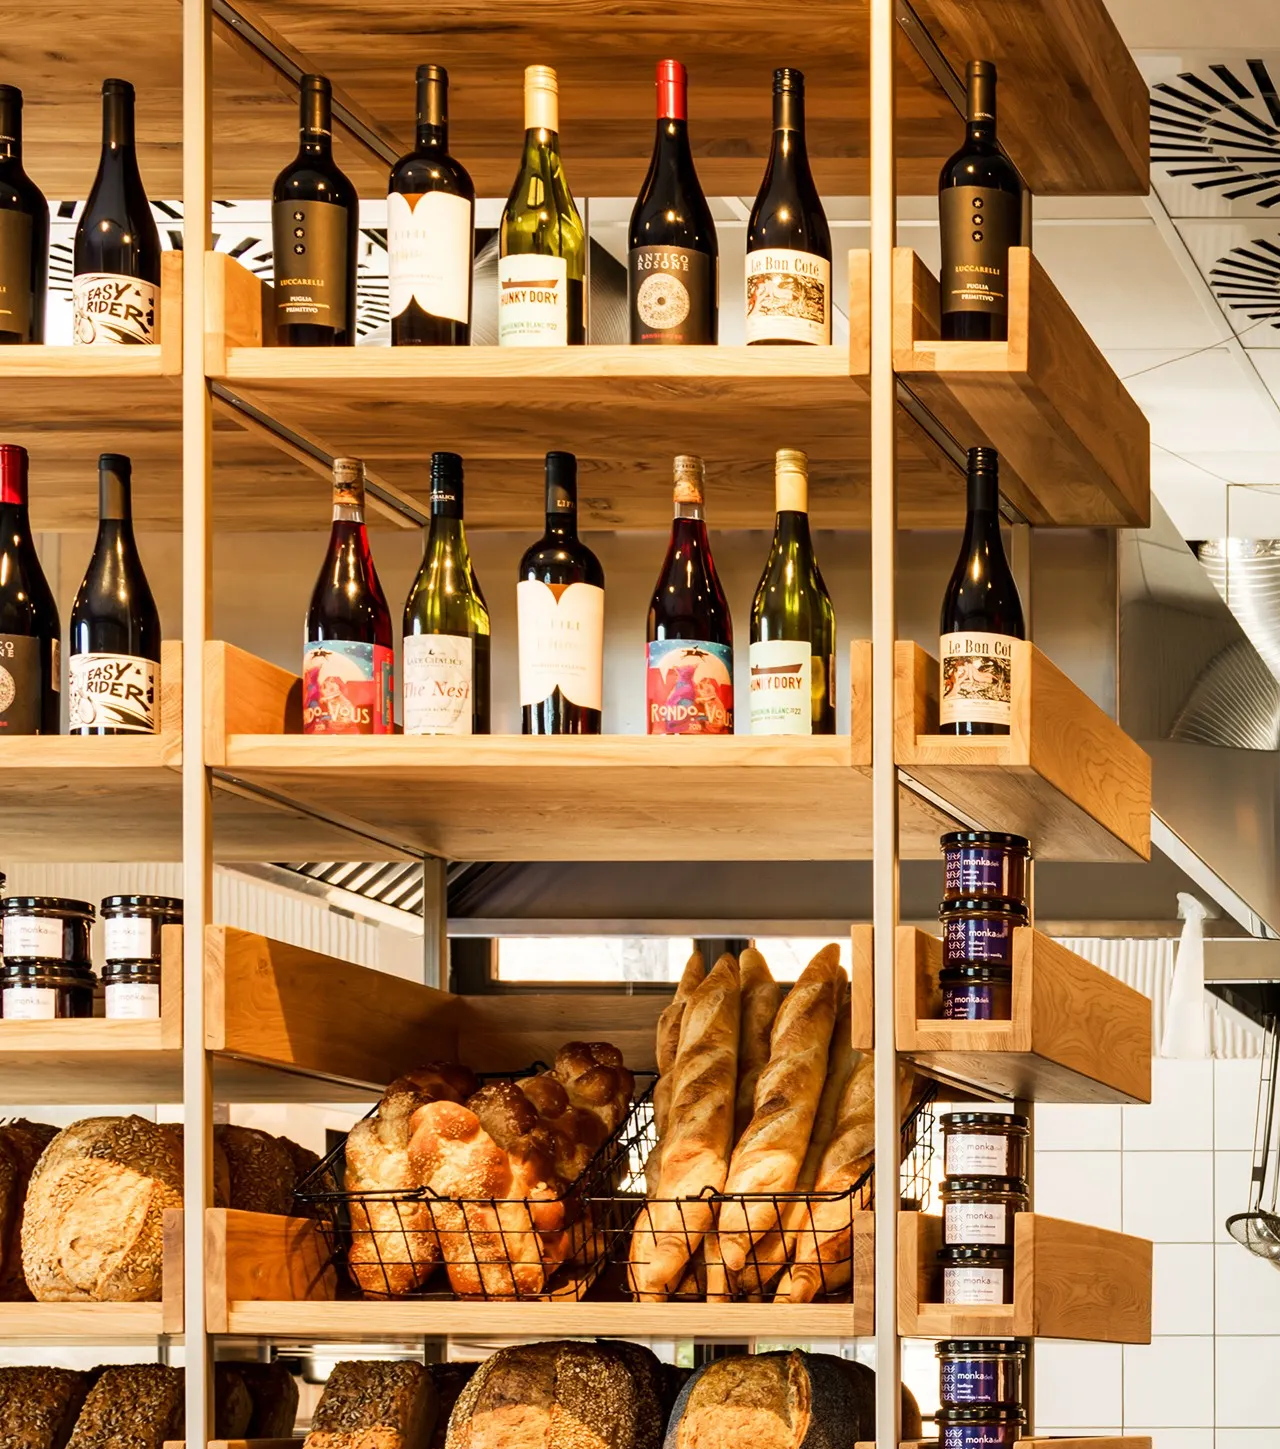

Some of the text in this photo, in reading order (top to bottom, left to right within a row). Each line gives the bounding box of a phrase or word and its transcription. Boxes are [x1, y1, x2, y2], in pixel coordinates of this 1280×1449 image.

[638, 253, 689, 263] ANTICO
[766, 256, 788, 270] Bon
[638, 261, 689, 271] ROSONE
[955, 265, 1000, 275] LUCCARELLI
[280, 278, 324, 287] LUCCARELLI
[88, 283, 132, 300] EASY
[529, 290, 559, 305] DORY
[961, 294, 994, 302] PRIMITIVO
[86, 301, 150, 334] RIDER
[949, 641, 961, 654] Le
[965, 639, 989, 654] Bon
[88, 662, 132, 681] EASY
[432, 680, 470, 699] Nest
[775, 677, 802, 690] DORY
[86, 681, 150, 712] RIDER
